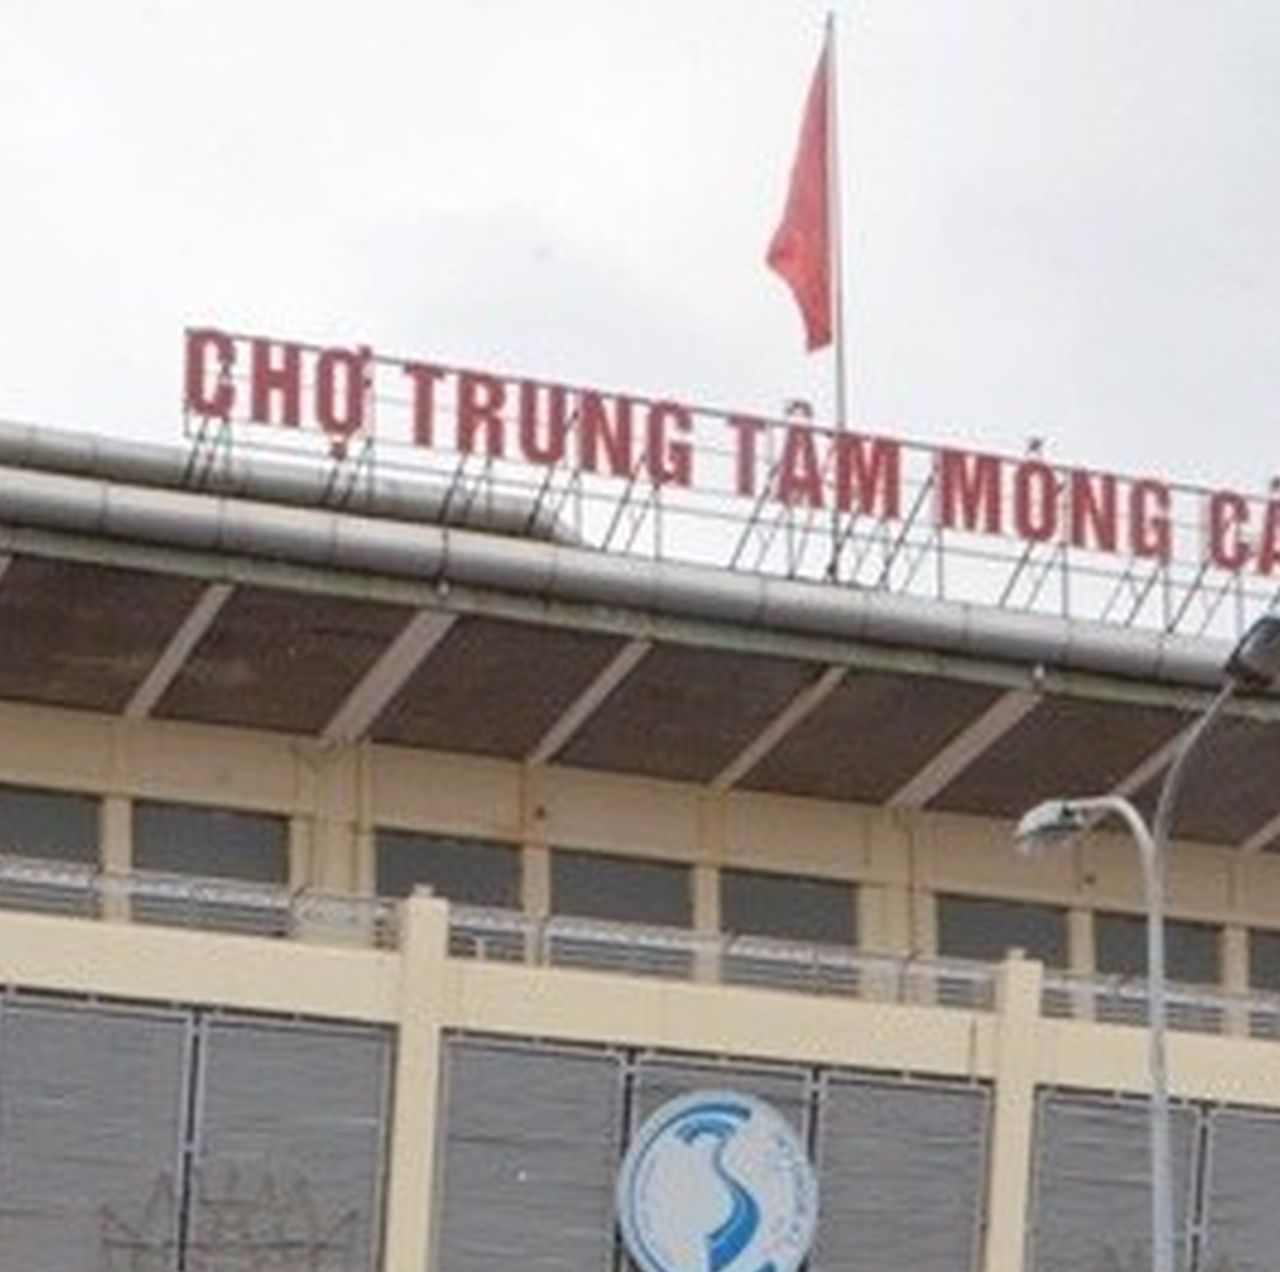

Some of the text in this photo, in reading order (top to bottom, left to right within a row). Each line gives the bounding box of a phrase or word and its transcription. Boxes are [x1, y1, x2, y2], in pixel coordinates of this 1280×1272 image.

[185, 329, 372, 460] CHỢ
[404, 362, 694, 488] TRUNG
[728, 400, 901, 520] TÂM
[938, 437, 1173, 566] MÓNG
